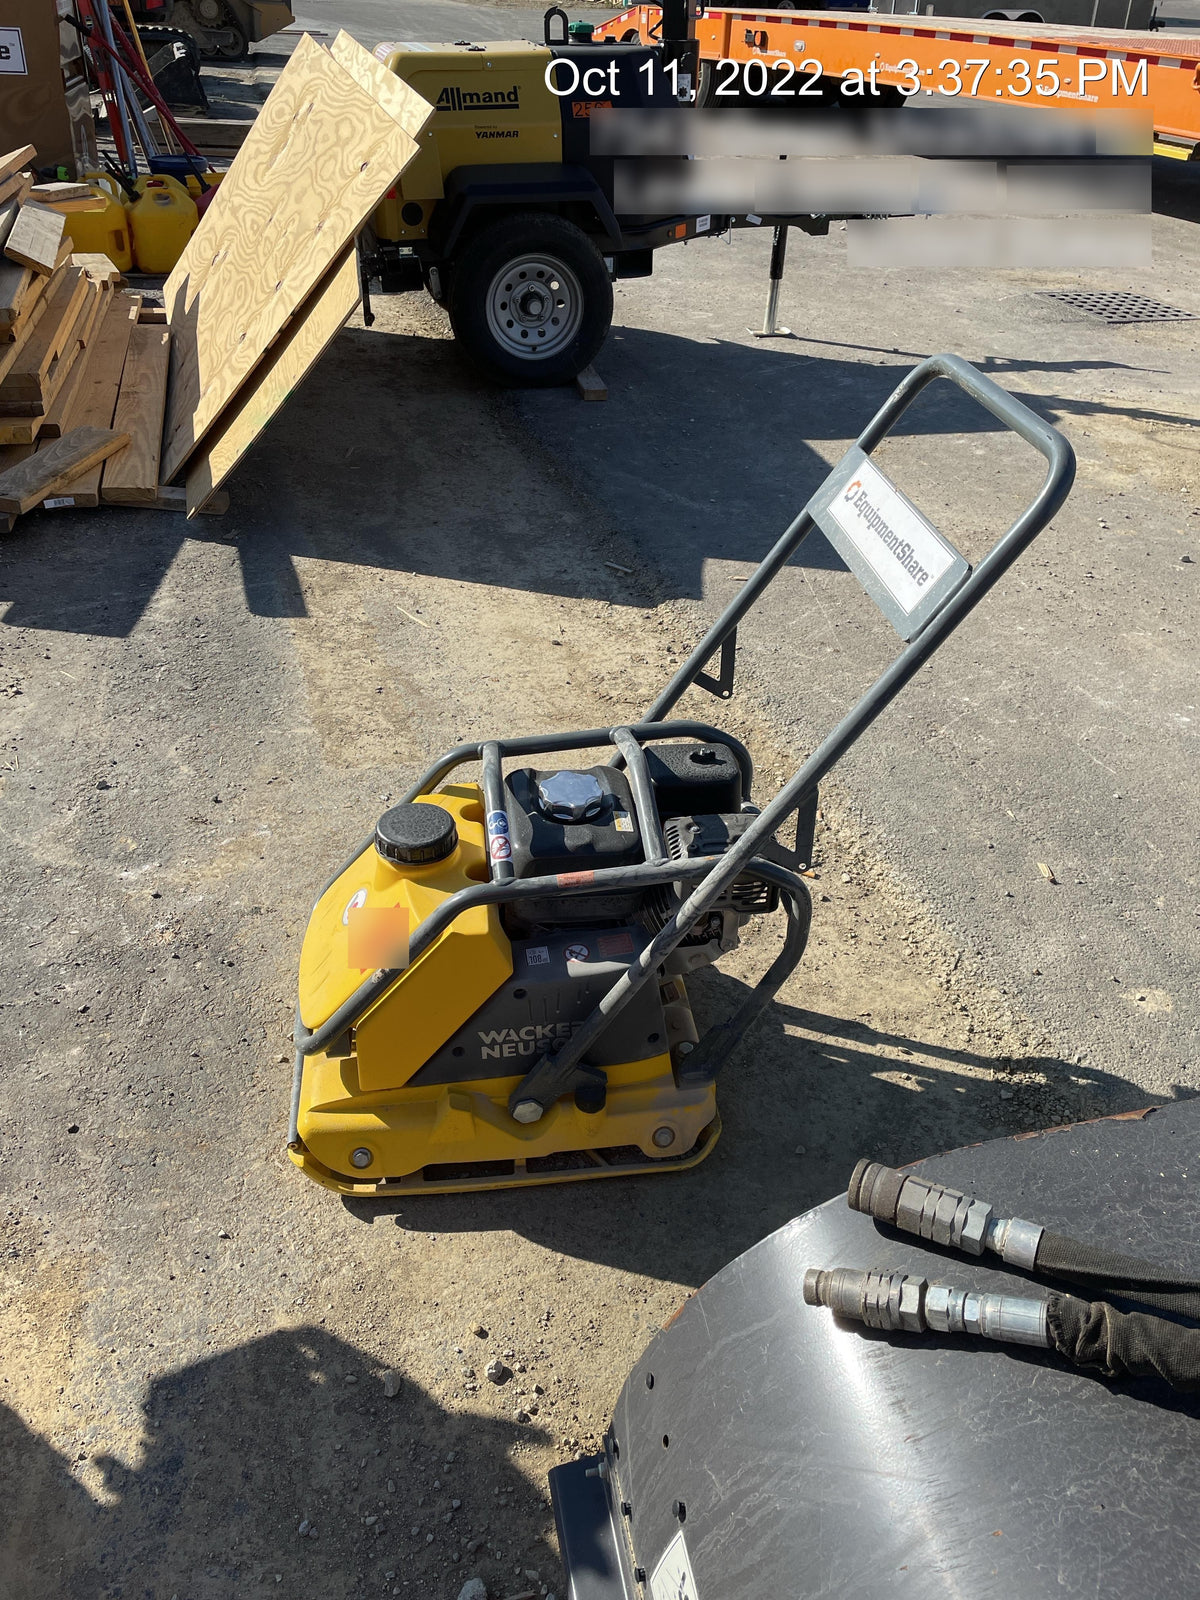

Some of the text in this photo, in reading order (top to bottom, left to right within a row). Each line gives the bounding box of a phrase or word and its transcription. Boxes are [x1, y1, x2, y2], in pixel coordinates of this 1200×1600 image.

[436, 86, 520, 111] Allmand
[475, 130, 519, 139] YANMAR
[853, 490, 930, 587] EquipmentShare
